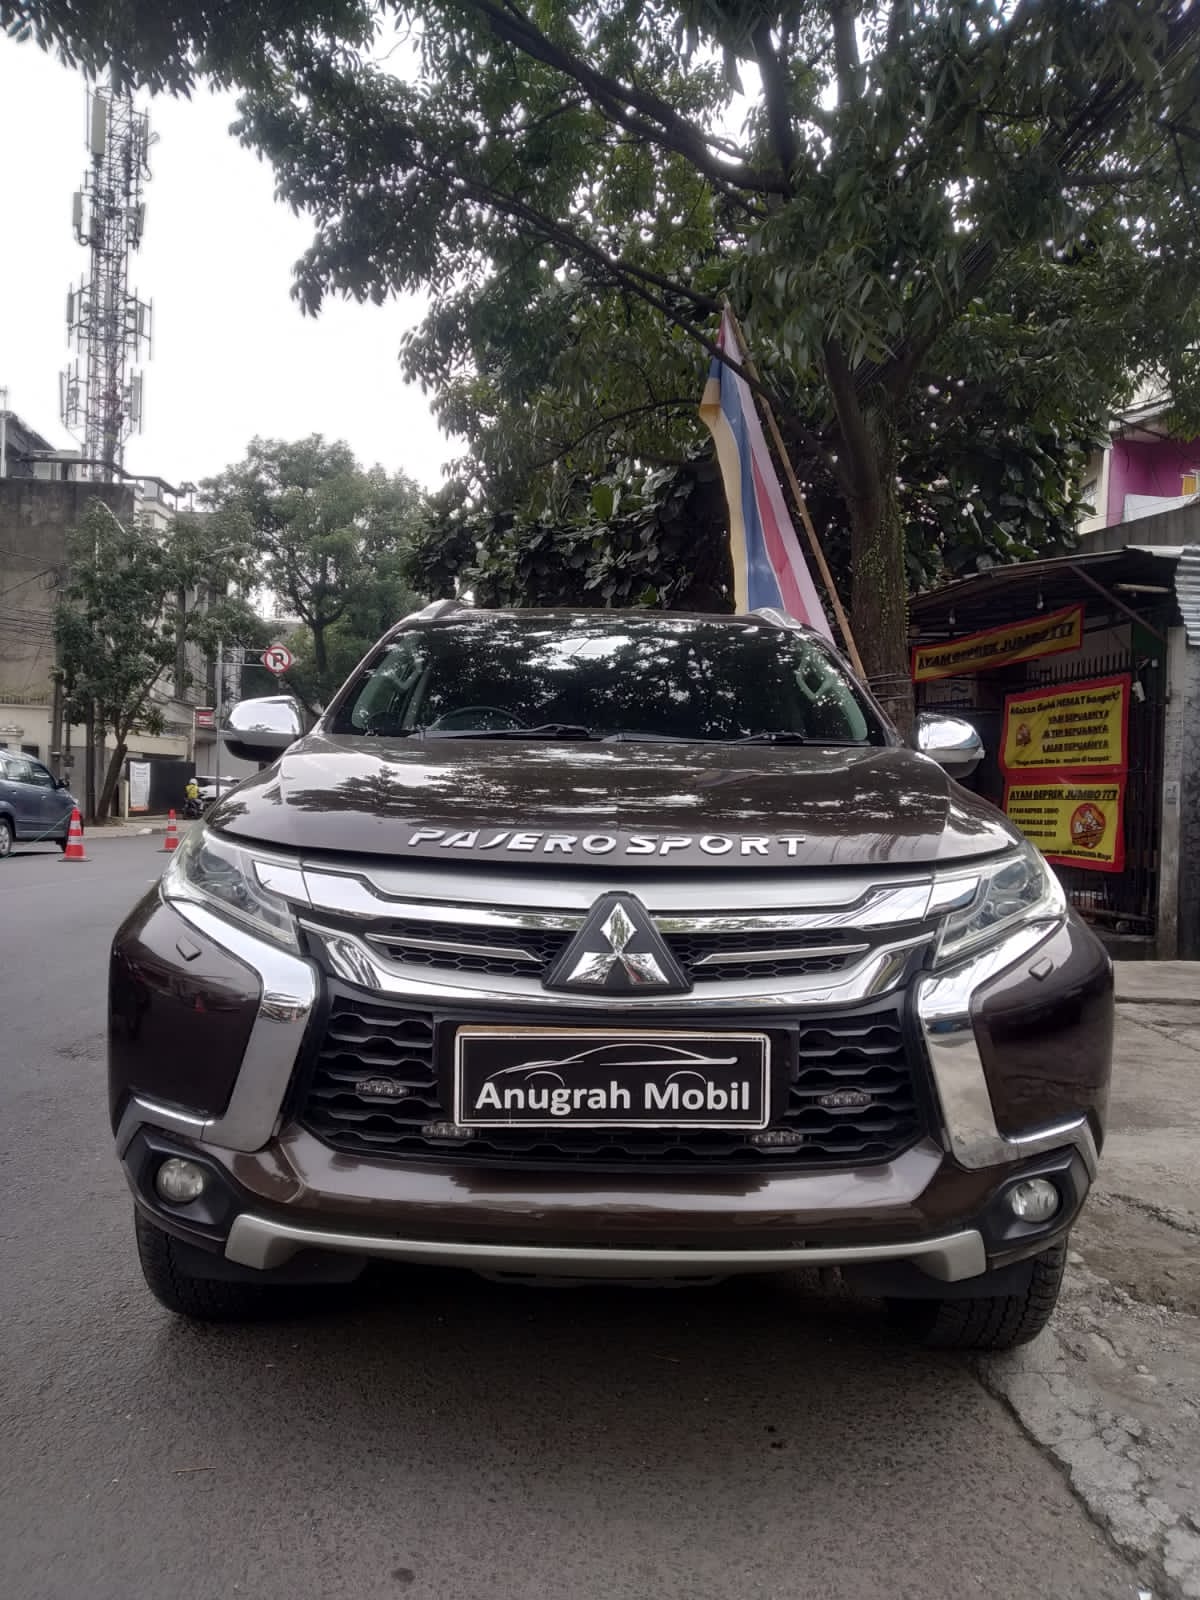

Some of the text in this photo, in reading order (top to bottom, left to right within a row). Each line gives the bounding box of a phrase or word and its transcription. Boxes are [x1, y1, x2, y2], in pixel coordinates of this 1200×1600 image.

[918, 655, 950, 670] AYAM
[1009, 790, 1032, 800] AYAM
[1033, 790, 1064, 800] GEPREK
[407, 827, 806, 857] PAJERO SPORT
[475, 1081, 750, 1116] Anugrah Mobil
